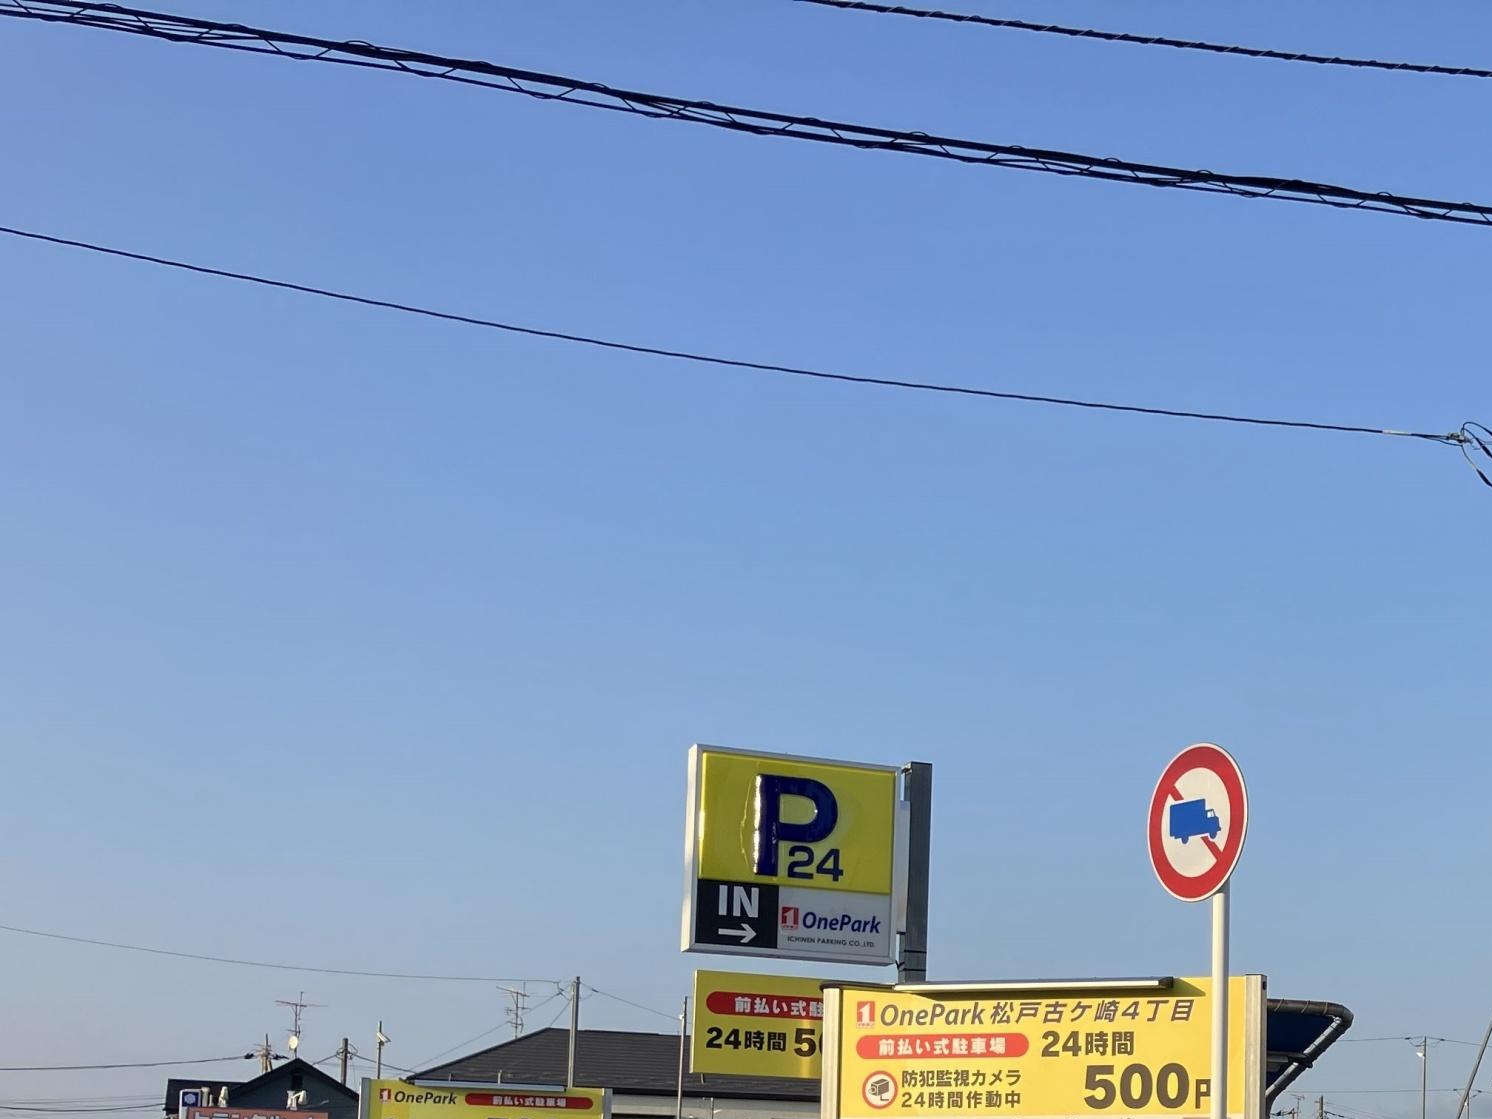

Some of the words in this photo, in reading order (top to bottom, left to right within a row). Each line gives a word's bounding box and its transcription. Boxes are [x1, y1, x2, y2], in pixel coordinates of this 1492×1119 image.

[754, 774, 838, 877] P
[787, 844, 844, 882] 24
[718, 885, 760, 918] IN
[802, 911, 881, 934] OnePark
[817, 936, 847, 946] PARKING
[880, 1001, 986, 1026] OnePark
[706, 1026, 787, 1052] 24時間
[793, 1027, 823, 1058] 5
[878, 1037, 1006, 1056] 前払い式駐車場
[1041, 1030, 1135, 1057] 24時間
[901, 1069, 1022, 1088] 防犯監視カメラ
[394, 1090, 457, 1105] OnePark
[901, 1090, 1021, 1109] 24時間作動中
